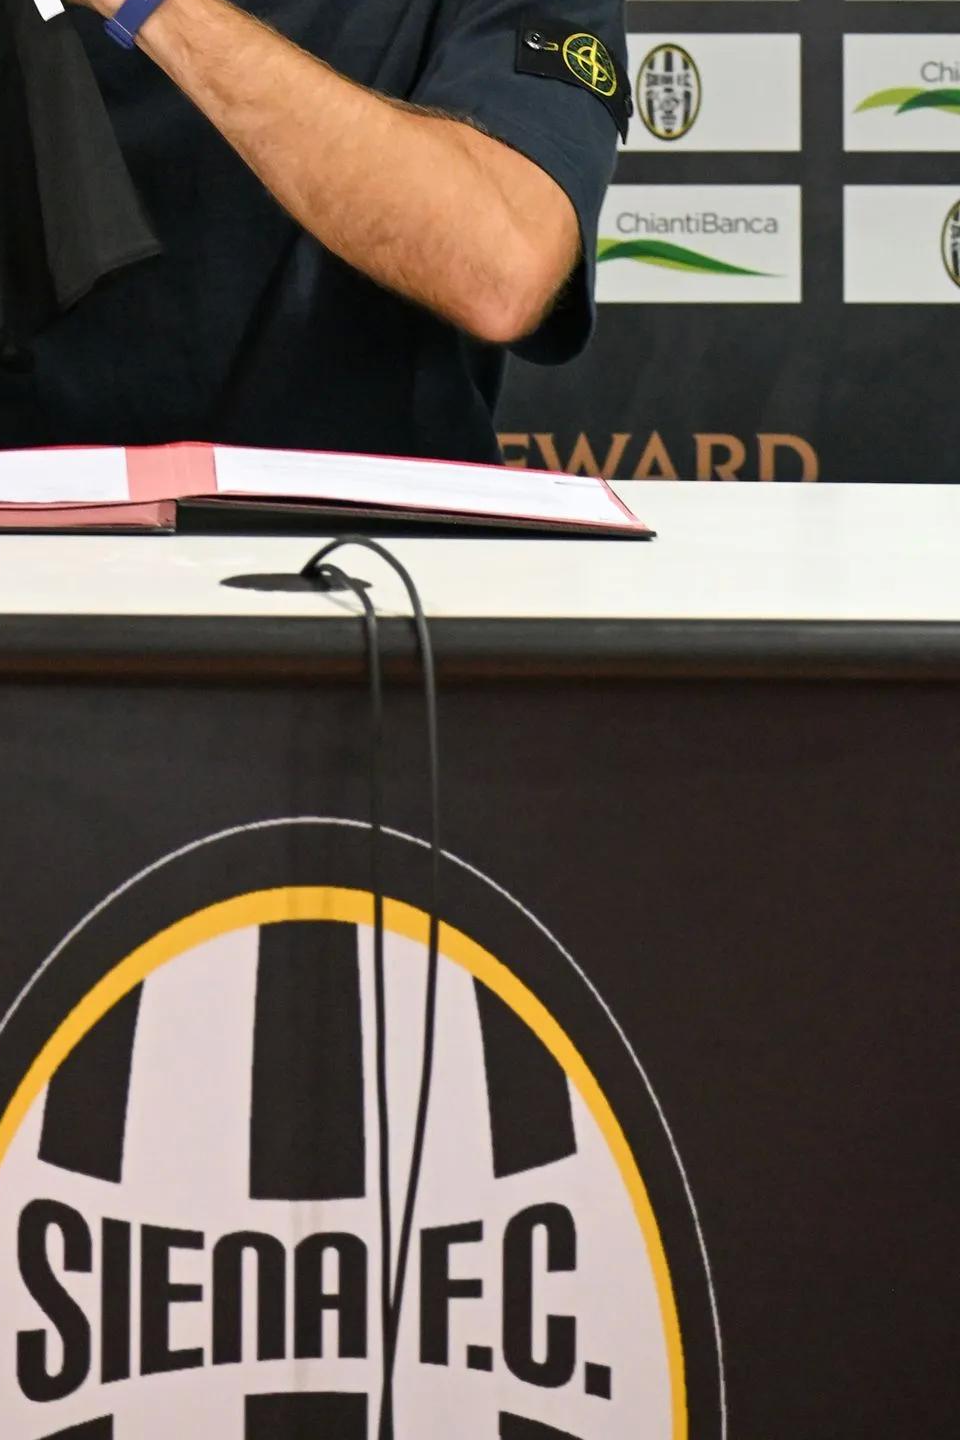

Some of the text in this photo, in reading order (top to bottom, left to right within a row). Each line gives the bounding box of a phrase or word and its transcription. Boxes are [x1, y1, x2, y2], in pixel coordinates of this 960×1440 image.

[615, 211, 779, 234] ChiantiBanca
[16, 1198, 613, 1402] SIENA F.C.
